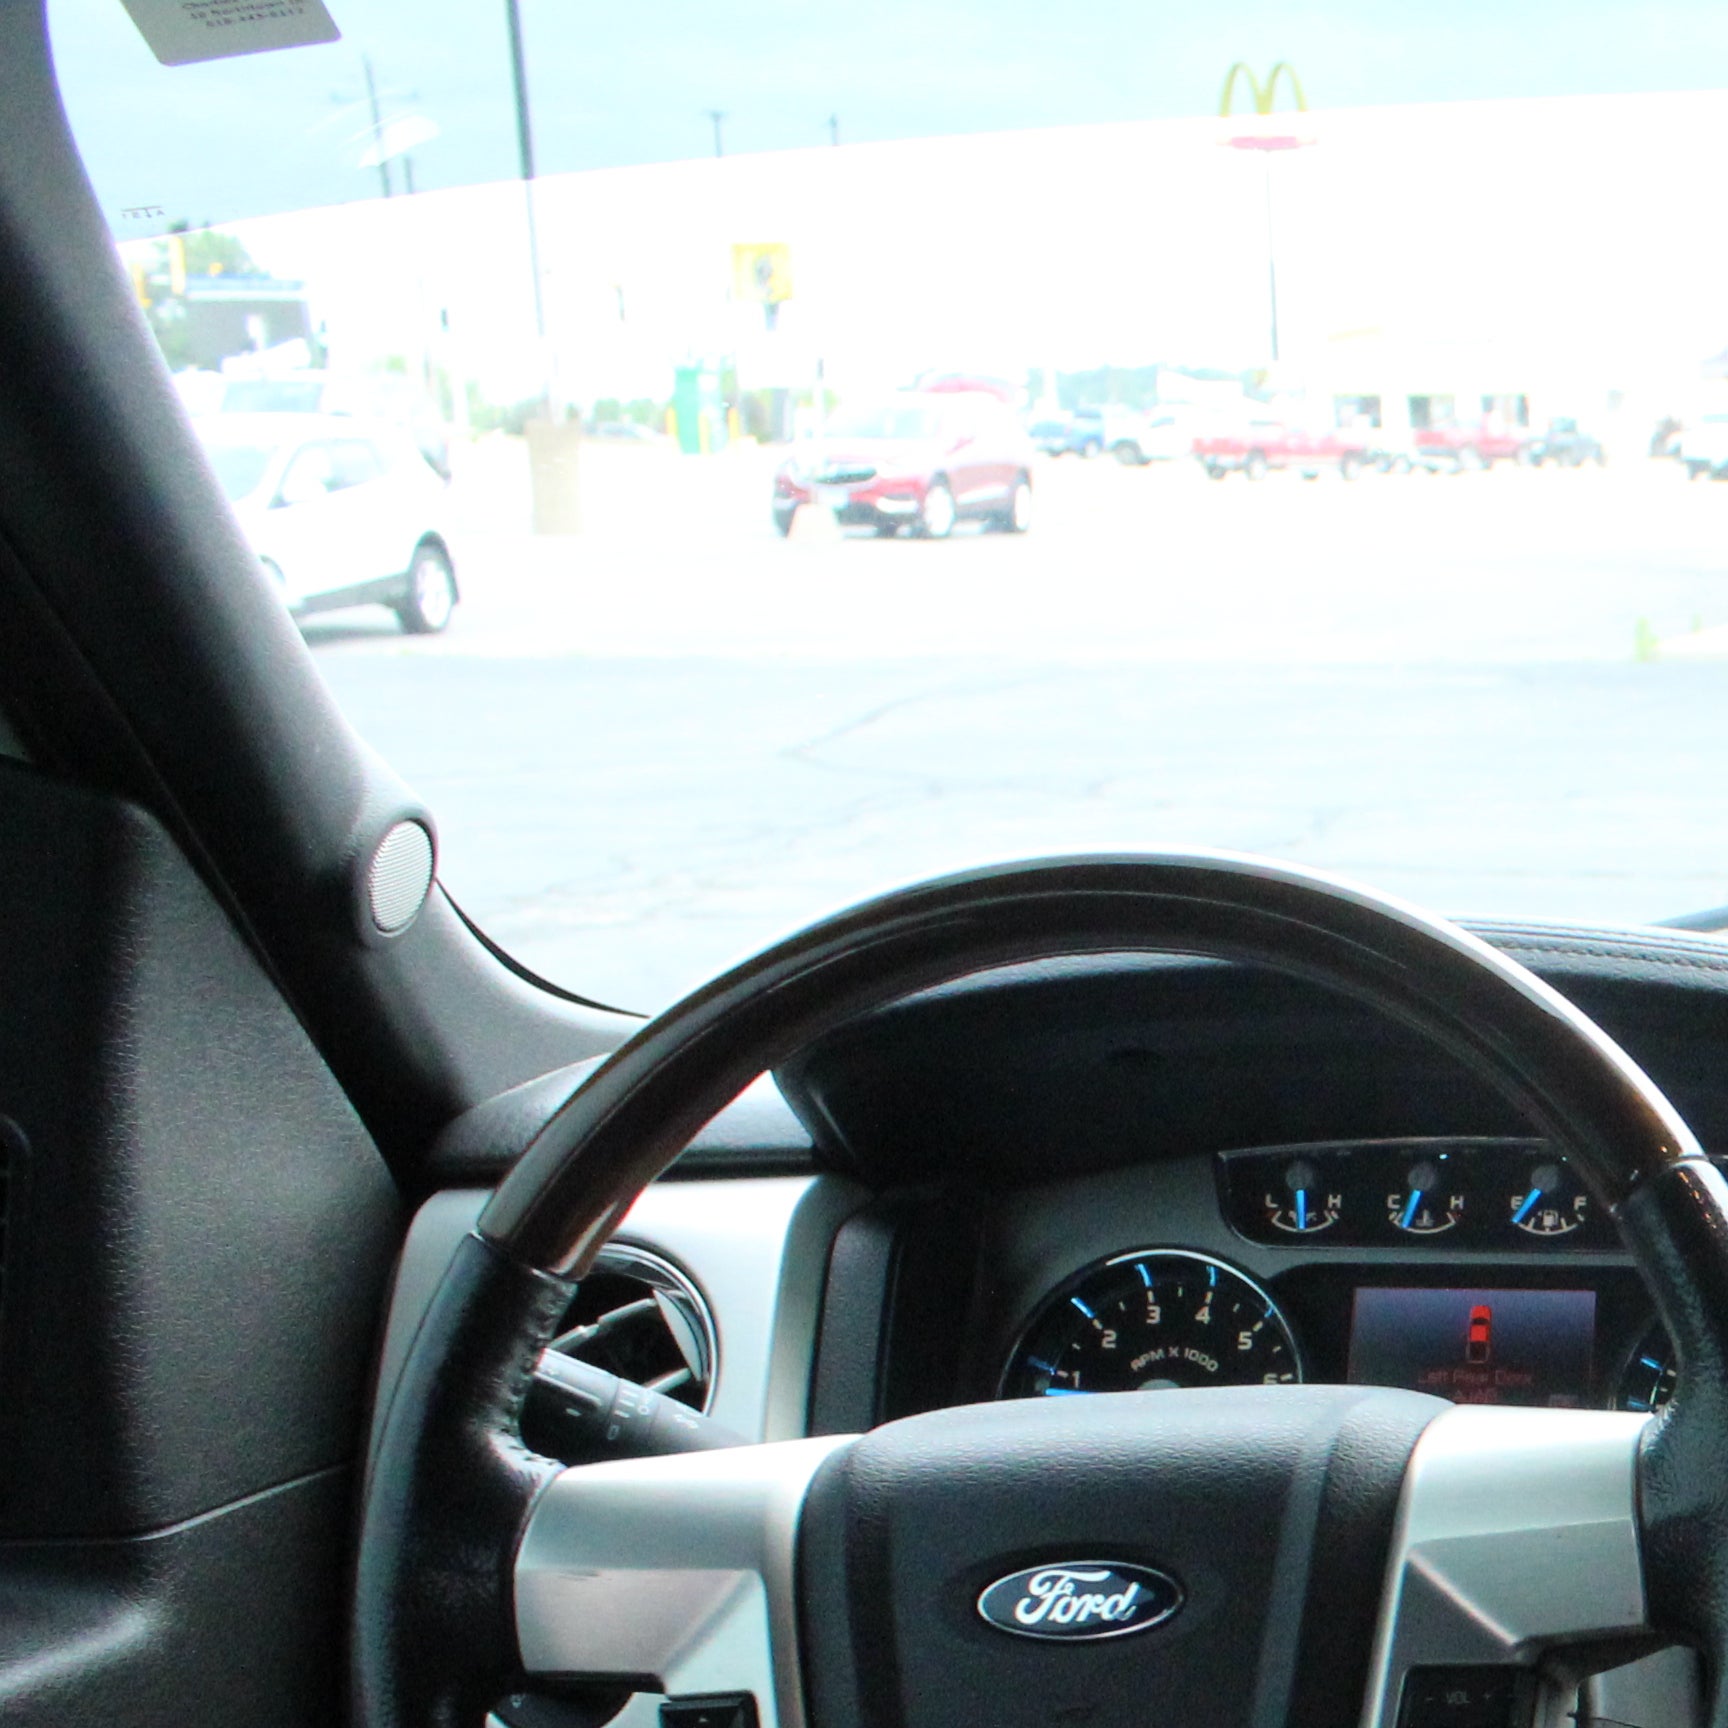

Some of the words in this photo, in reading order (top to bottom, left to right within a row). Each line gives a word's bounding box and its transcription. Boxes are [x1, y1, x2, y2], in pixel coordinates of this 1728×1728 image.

[1327, 1194, 1341, 1209] H
[1388, 1194, 1400, 1209] C
[1450, 1196, 1464, 1210] H
[1574, 1195, 1587, 1211] F
[1145, 1305, 1161, 1324] 3
[1194, 1305, 1212, 1325] 4
[1100, 1331, 1117, 1349] 2
[1237, 1331, 1253, 1351] 5
[1130, 1347, 1165, 1372] RPM
[1184, 1347, 1220, 1373] 1000
[1071, 1371, 1081, 1388] 1
[1015, 1569, 1140, 1625] Ford
[1444, 1690, 1471, 1705] VOL
